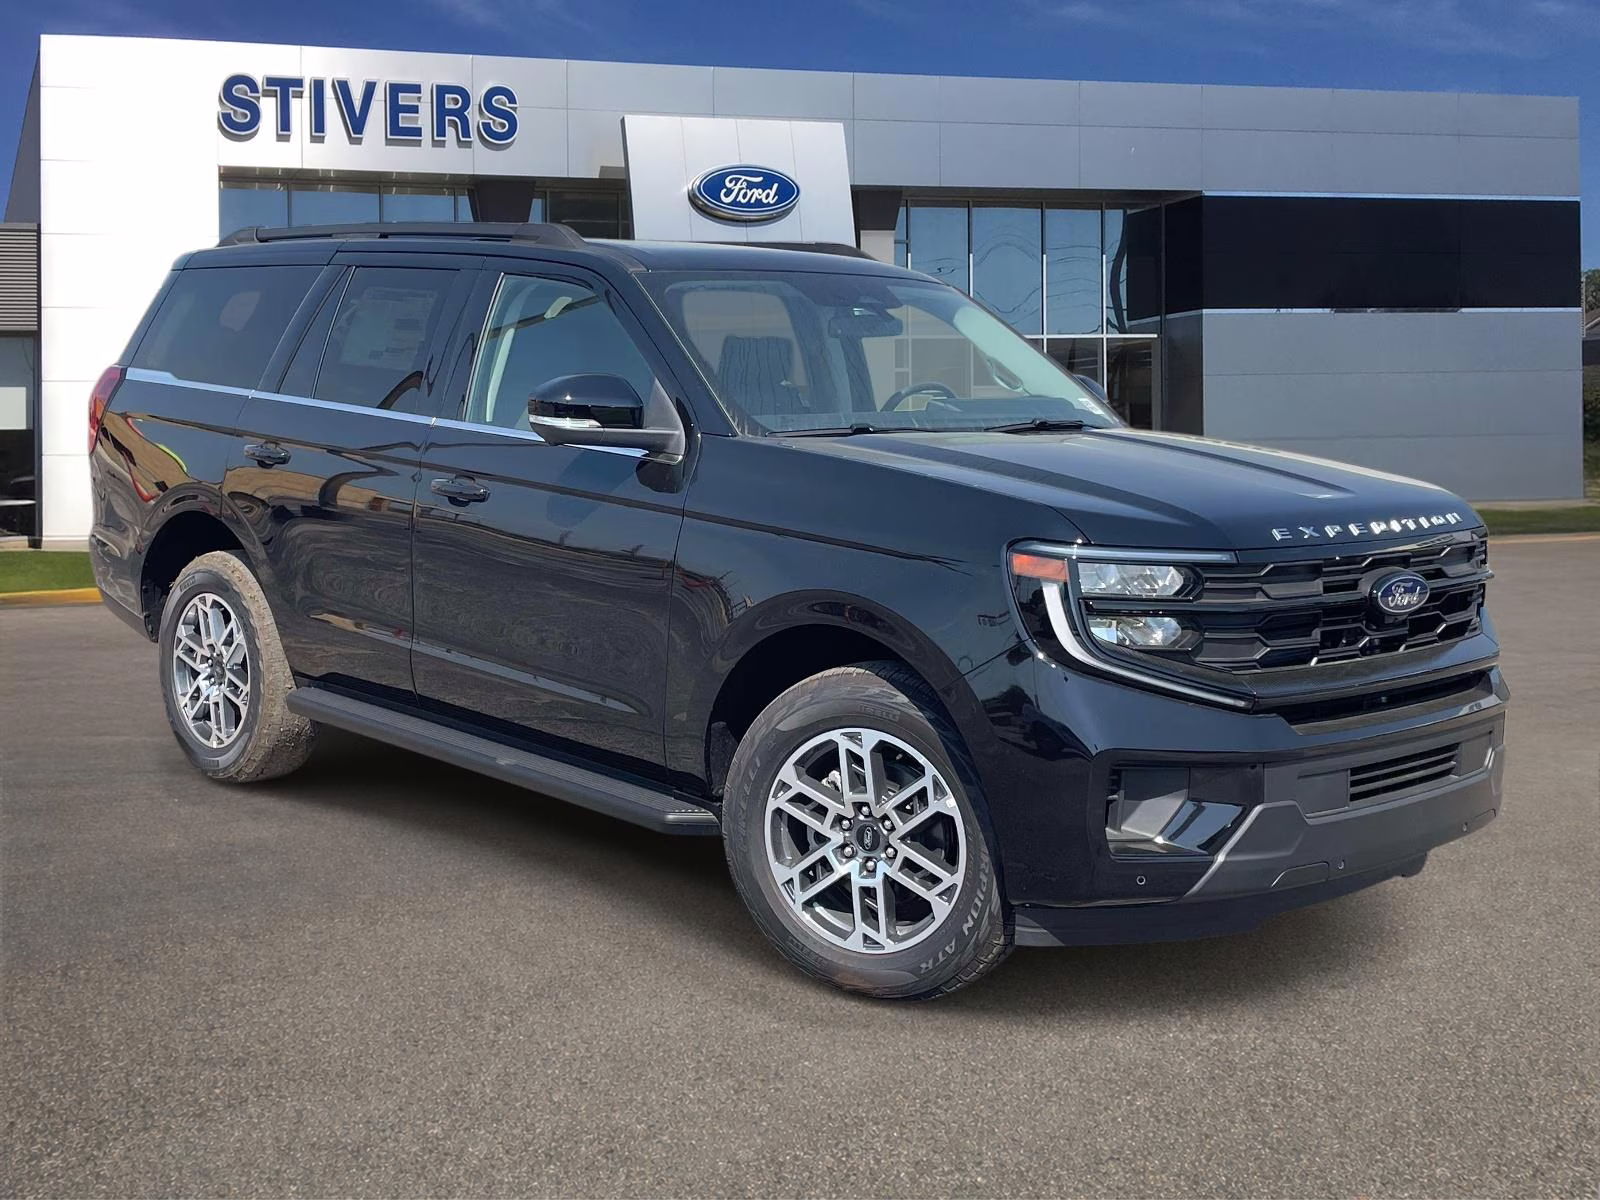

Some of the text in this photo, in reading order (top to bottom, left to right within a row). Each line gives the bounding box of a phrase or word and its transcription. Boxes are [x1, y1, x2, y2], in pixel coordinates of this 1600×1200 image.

[217, 73, 519, 146] STIVERS
[720, 174, 779, 204] Ford
[1271, 511, 1464, 541] EXPEDITION
[1388, 581, 1421, 607] Ford
[919, 937, 957, 974] ATR
